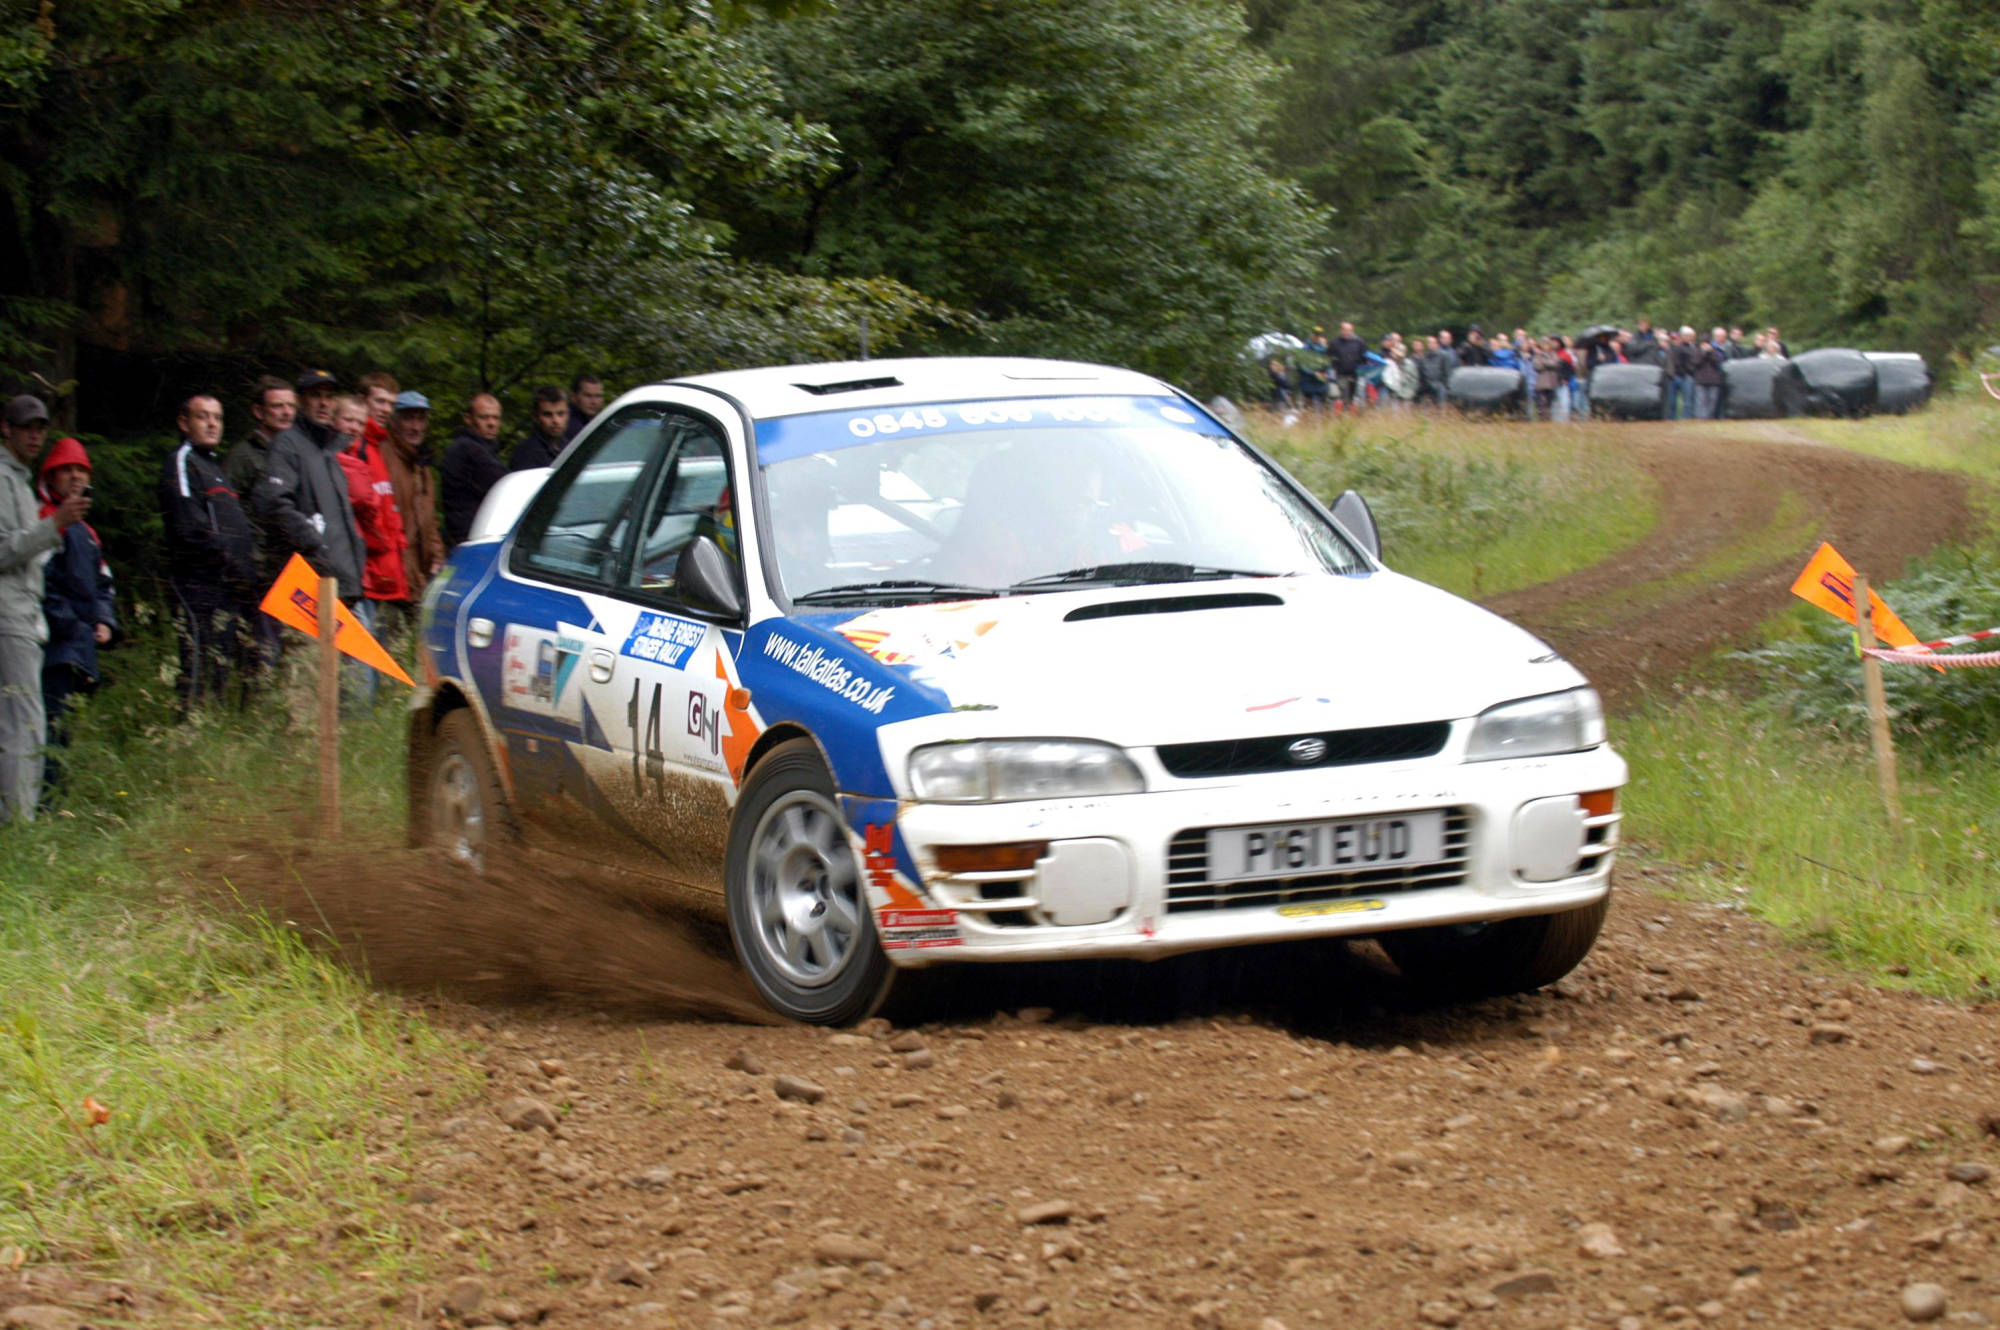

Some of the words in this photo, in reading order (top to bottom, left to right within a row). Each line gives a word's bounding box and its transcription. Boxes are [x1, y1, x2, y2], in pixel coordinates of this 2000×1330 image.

[848, 407, 947, 437] 0845
[671, 621, 706, 648] FOREST
[656, 642, 687, 666] RALLY
[763, 631, 896, 715] www.talkatlas.co.uk
[627, 677, 665, 802] 14
[1333, 820, 1411, 865] EUD
